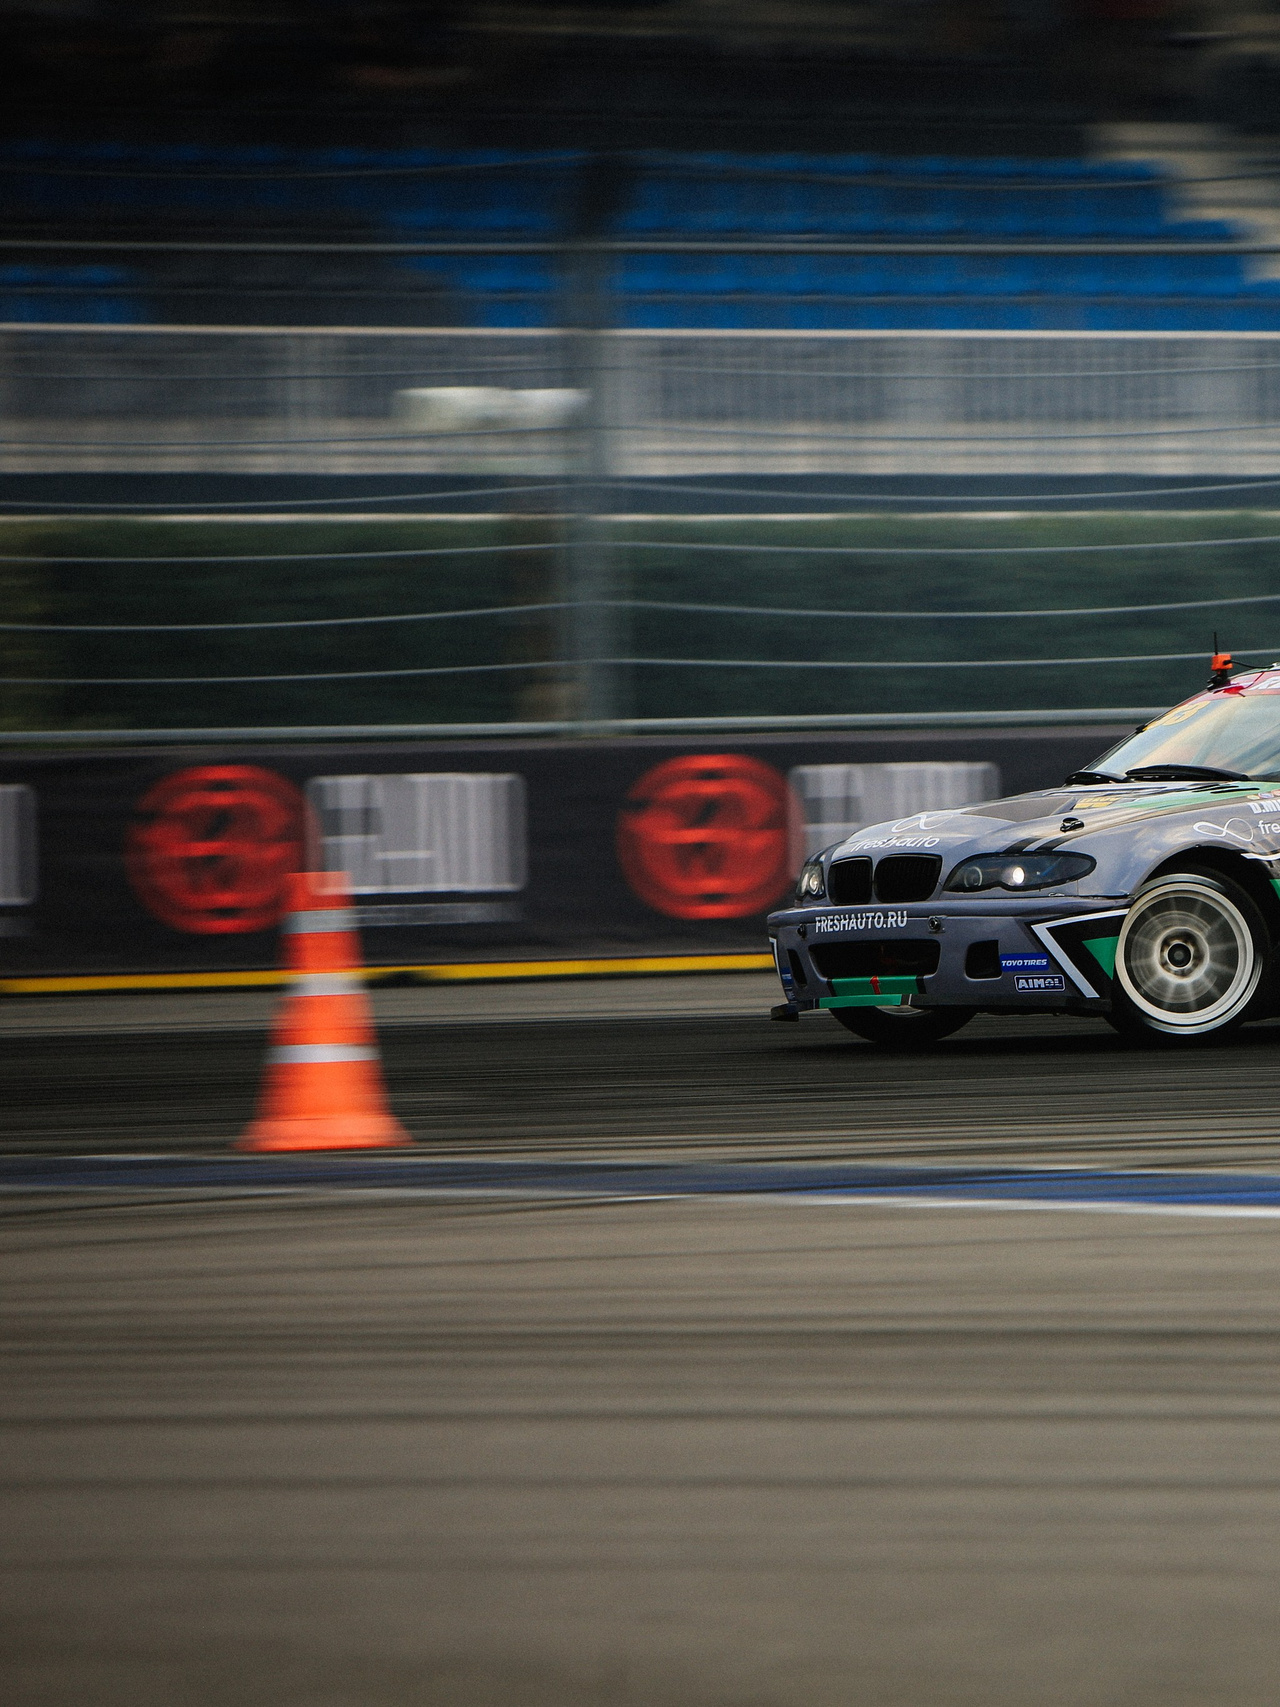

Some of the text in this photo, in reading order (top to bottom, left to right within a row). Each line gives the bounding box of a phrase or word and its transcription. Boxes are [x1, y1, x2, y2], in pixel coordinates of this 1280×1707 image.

[850, 835, 940, 852] fresh auto
[815, 910, 908, 934] FRESHAUTO.RU
[1002, 958, 1048, 967] TOYO TIRES
[1018, 978, 1062, 989] AIMOL
